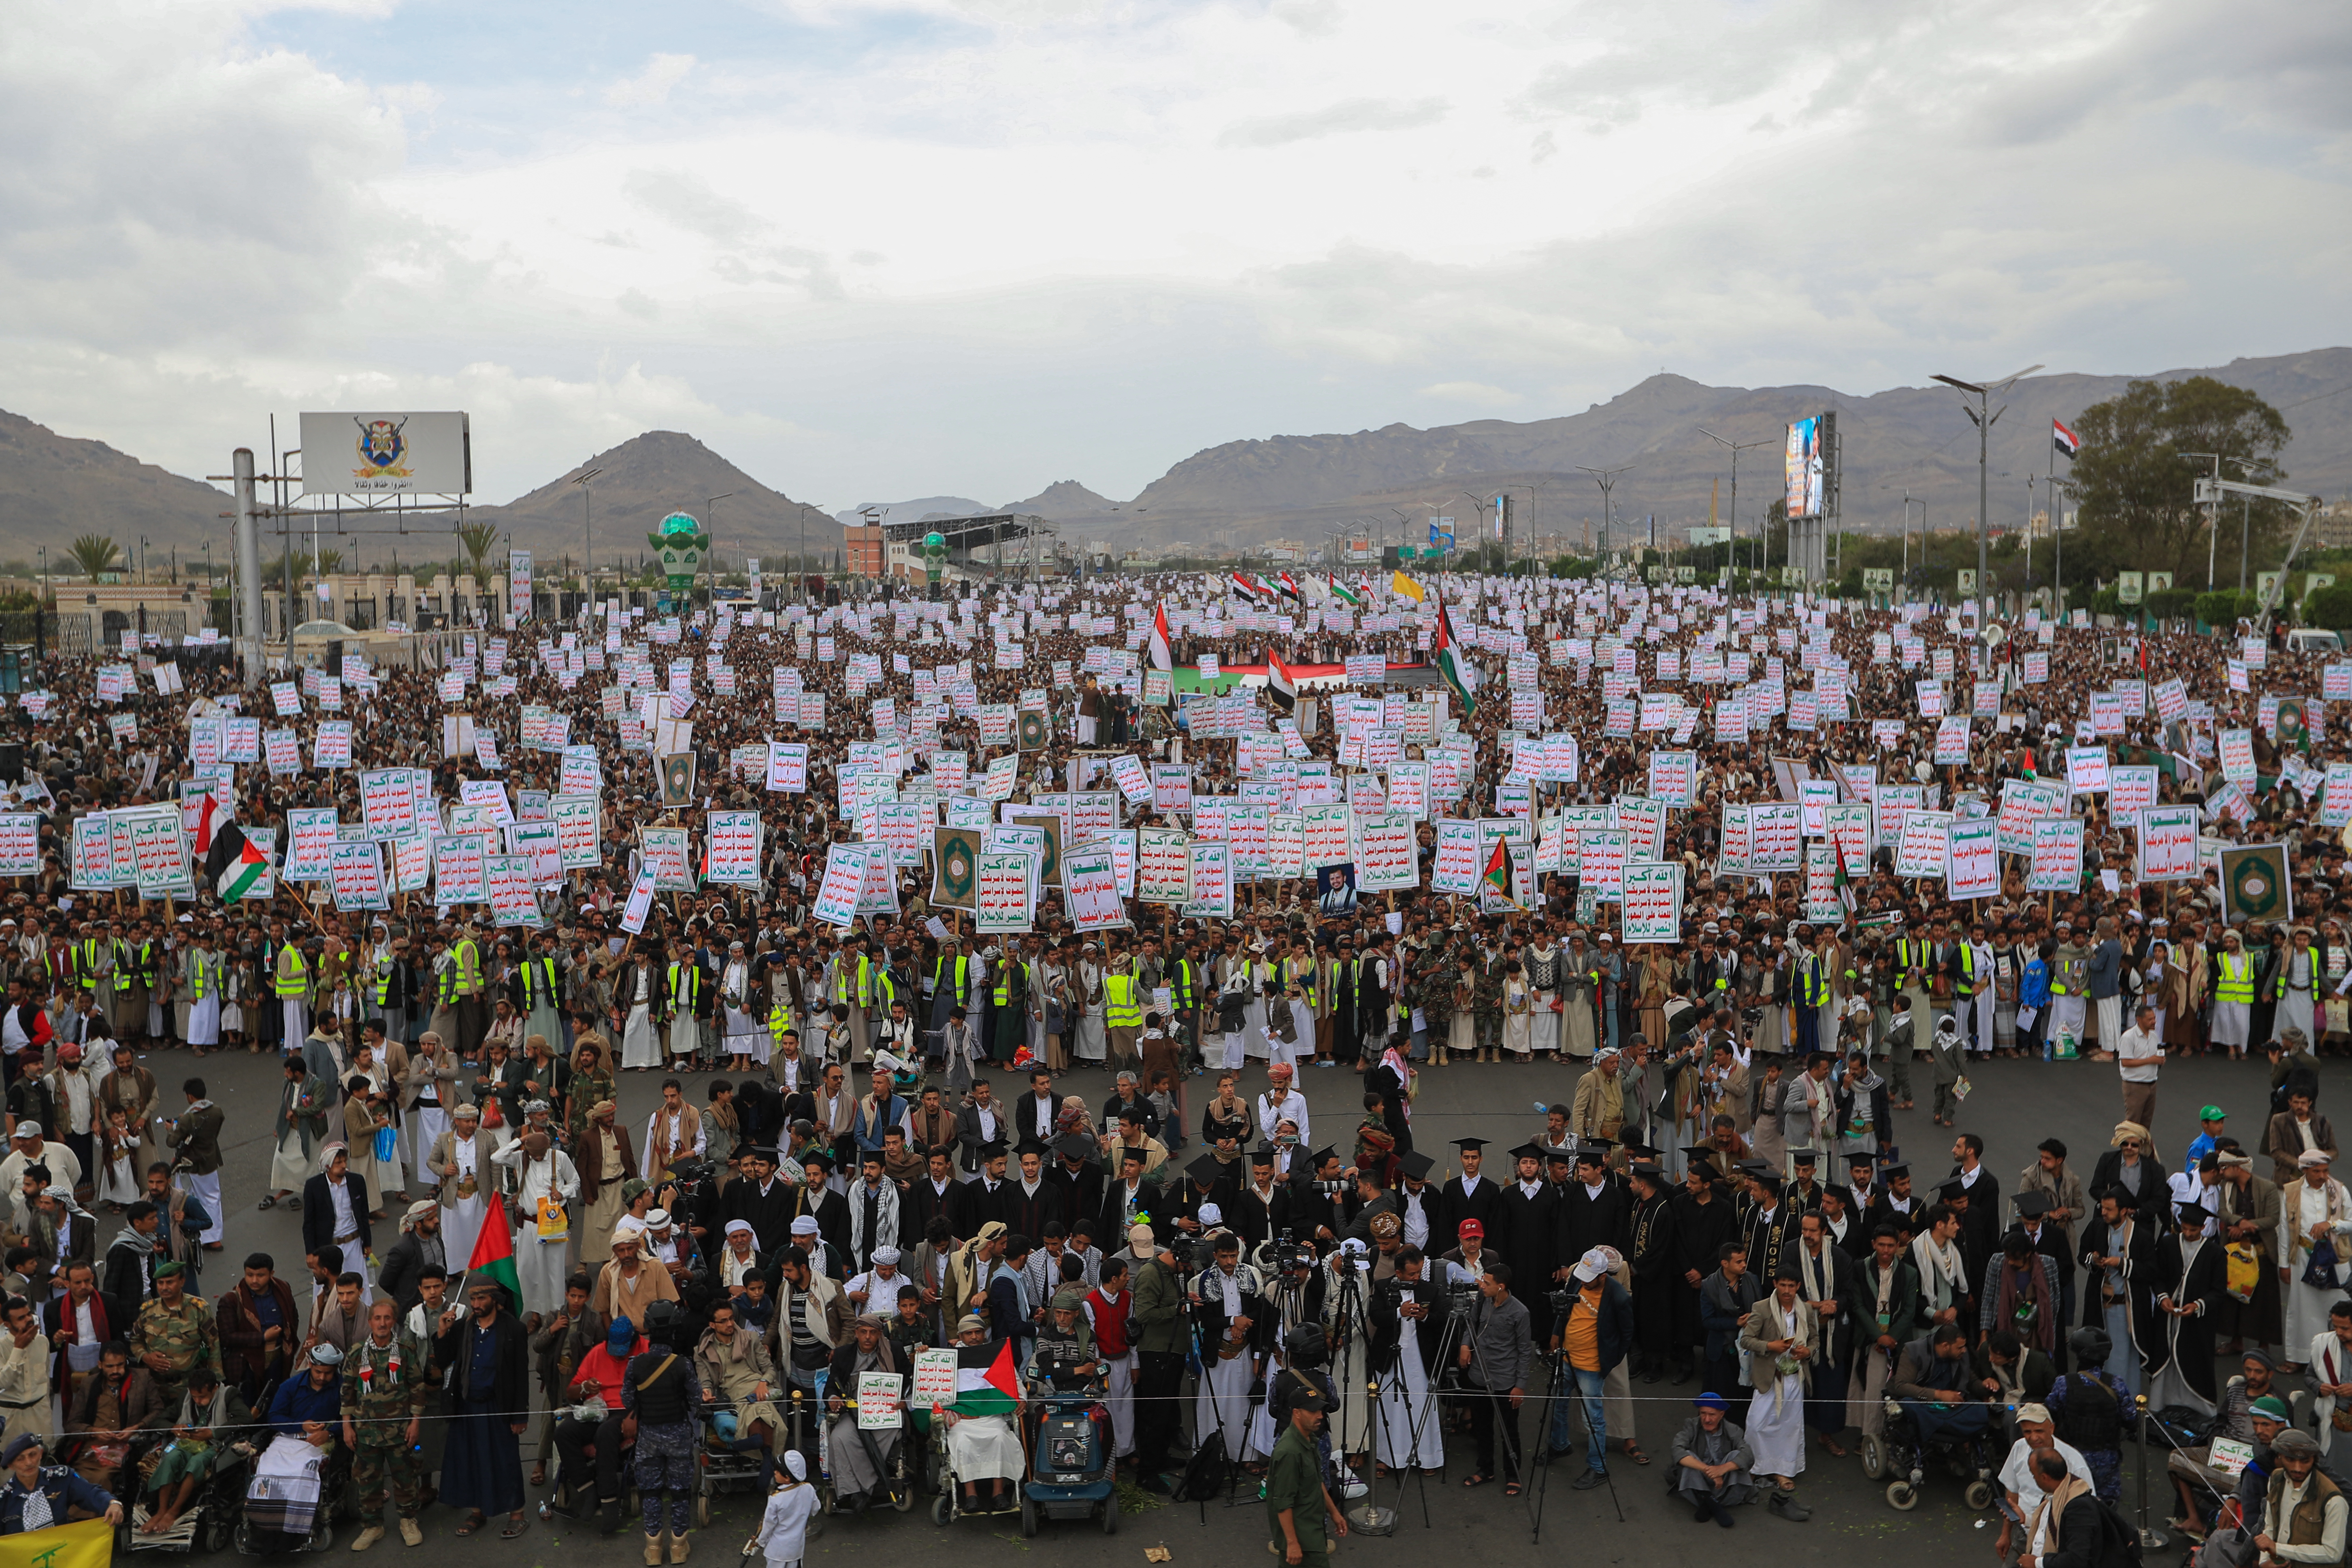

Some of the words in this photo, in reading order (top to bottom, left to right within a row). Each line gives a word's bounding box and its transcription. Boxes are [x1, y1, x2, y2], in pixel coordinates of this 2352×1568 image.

[1755, 806, 1781, 823] أكبر
[1782, 807, 1798, 818] الله
[712, 814, 738, 830] أكبر
[739, 815, 755, 827] الله
[1363, 814, 1395, 833] أكبر
[1394, 815, 1408, 827] الله
[1779, 822, 1798, 831] الموت
[737, 831, 755, 839] الموت
[1388, 832, 1408, 842] الموت
[1779, 833, 1798, 842] الموت
[737, 842, 755, 852] الموت
[1389, 844, 1409, 854] الموت
[1754, 845, 1770, 854] اليهود
[1772, 844, 1781, 854] على
[713, 854, 729, 864] اليهود
[730, 854, 739, 863] على
[741, 854, 755, 862] اللعنة
[1008, 857, 1025, 869] الله
[1384, 859, 1393, 867] على
[1753, 854, 1776, 867] للإسلام
[1777, 853, 1798, 866] النصر
[980, 856, 1007, 873] أكبر
[1366, 859, 1383, 868] اليهود
[713, 865, 735, 878] للإسلام
[736, 864, 755, 878] النصر
[1366, 869, 1391, 883] للإسلام
[1391, 868, 1411, 880] النصر
[1626, 867, 1653, 885] أكبر
[1655, 869, 1672, 880] الله
[1006, 874, 1025, 884] الموت
[1006, 887, 1025, 896] الموت
[1652, 885, 1672, 895] الموت
[980, 899, 997, 909] اليهود
[999, 899, 1008, 909] على
[1011, 899, 1026, 907] اللعنة
[1653, 898, 1673, 908] الموت
[981, 910, 1003, 924] للإسلام
[1006, 910, 1026, 923] النصر
[1627, 910, 1644, 921] اليهود
[1646, 910, 1655, 920] على
[1658, 910, 1673, 919] اللعنة
[1627, 922, 1651, 937] للإسلام
[1653, 921, 1673, 935] النصر
